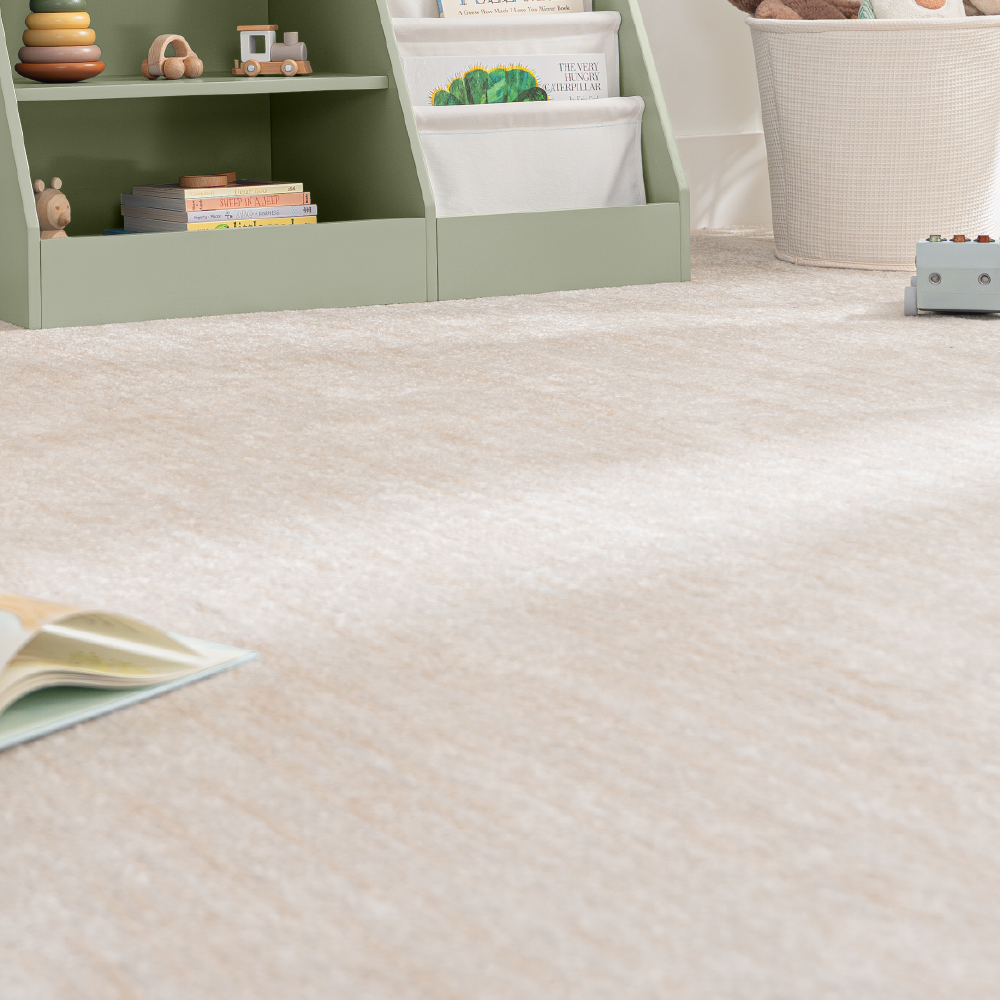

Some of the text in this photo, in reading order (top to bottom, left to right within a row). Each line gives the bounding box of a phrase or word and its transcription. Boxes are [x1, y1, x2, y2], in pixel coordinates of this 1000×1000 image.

[558, 62, 599, 72] THE VERY
[564, 72, 600, 82] HUNGRY
[544, 83, 602, 92] CATERPILLAR
[220, 198, 242, 208] SHEEP
[255, 197, 261, 206] A
[262, 195, 280, 207] JEEP
